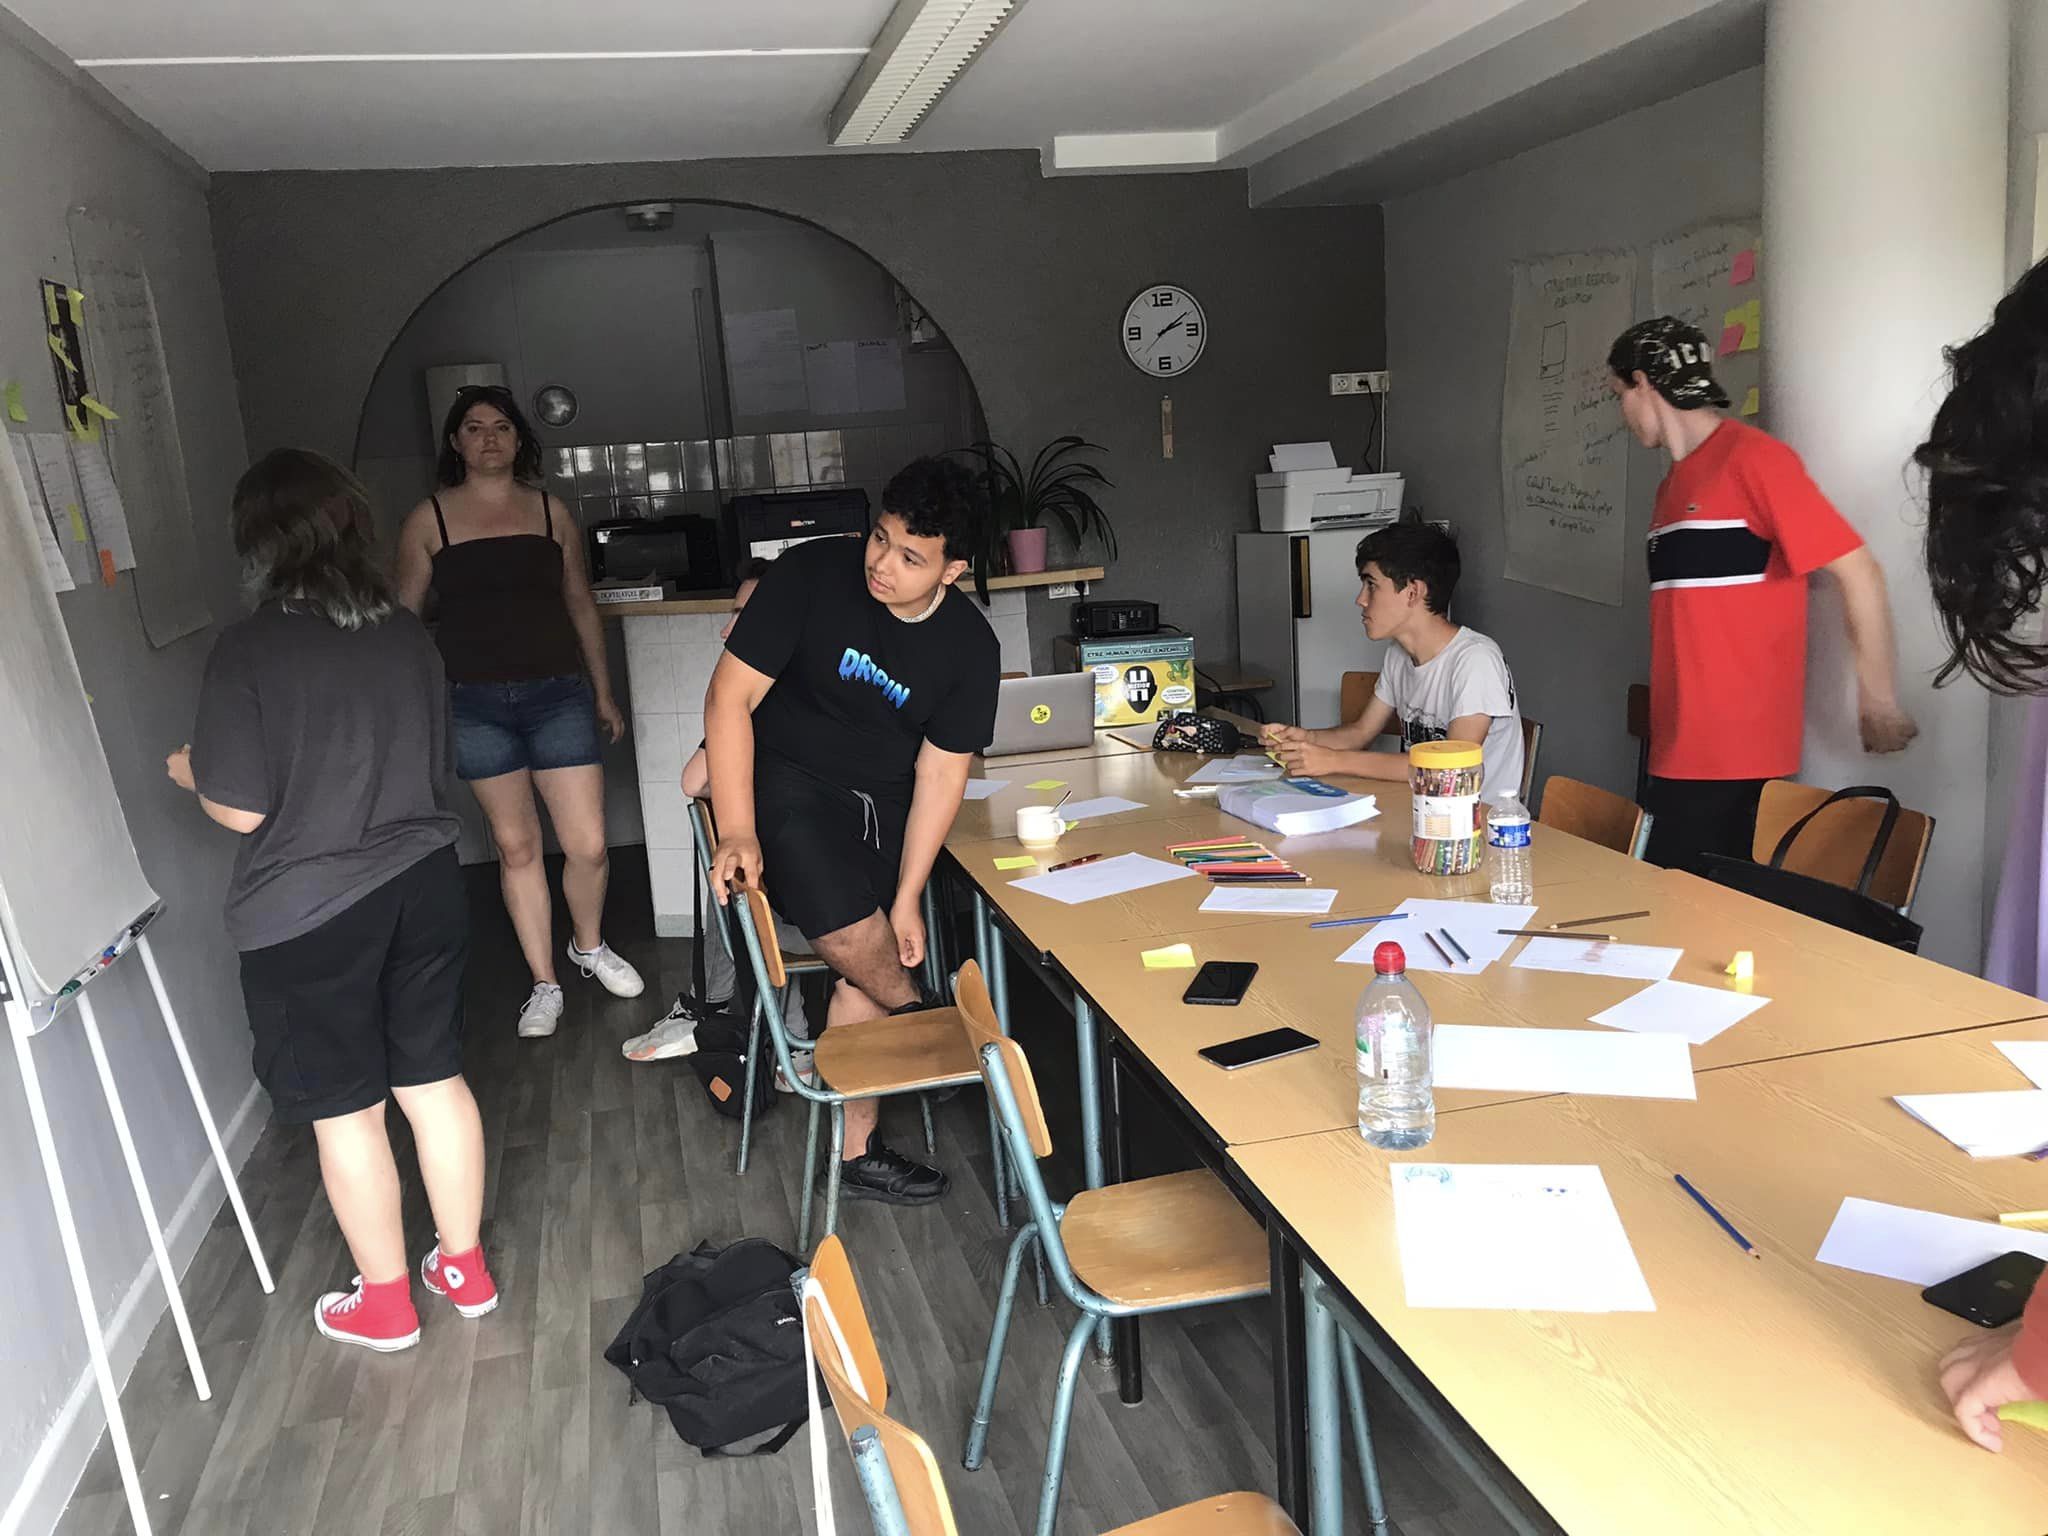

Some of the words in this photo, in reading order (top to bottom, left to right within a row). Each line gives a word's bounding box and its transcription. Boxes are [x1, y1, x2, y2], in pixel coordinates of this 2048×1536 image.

[1151, 292, 1173, 307] 12
[1128, 326, 1141, 341] 9
[1186, 322, 1199, 337] 3
[1158, 356, 1172, 370] 6
